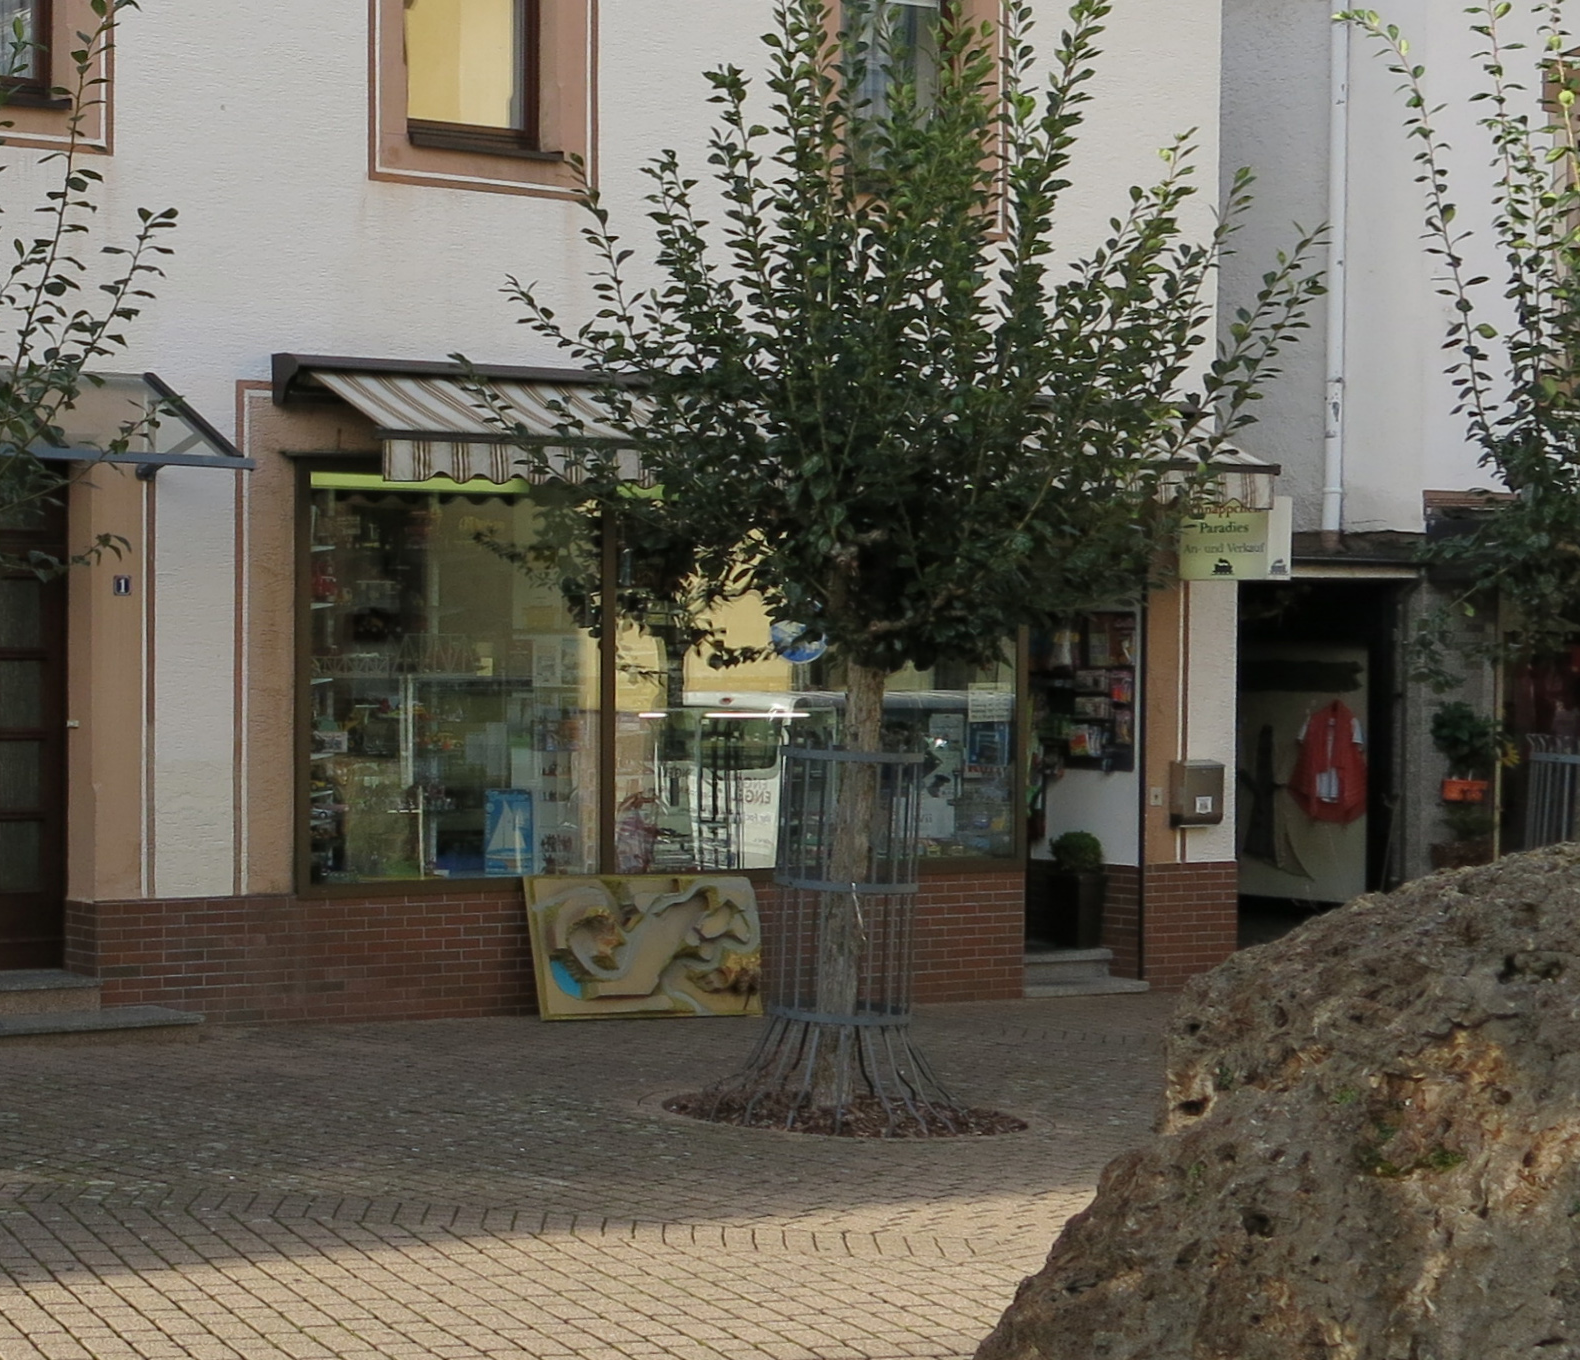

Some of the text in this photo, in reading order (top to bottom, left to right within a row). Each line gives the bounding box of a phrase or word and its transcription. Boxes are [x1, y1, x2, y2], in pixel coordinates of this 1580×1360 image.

[1199, 521, 1250, 534] Paradies
[1183, 542, 1265, 554] An- und Verkauf
[118, 578, 126, 593] 1
